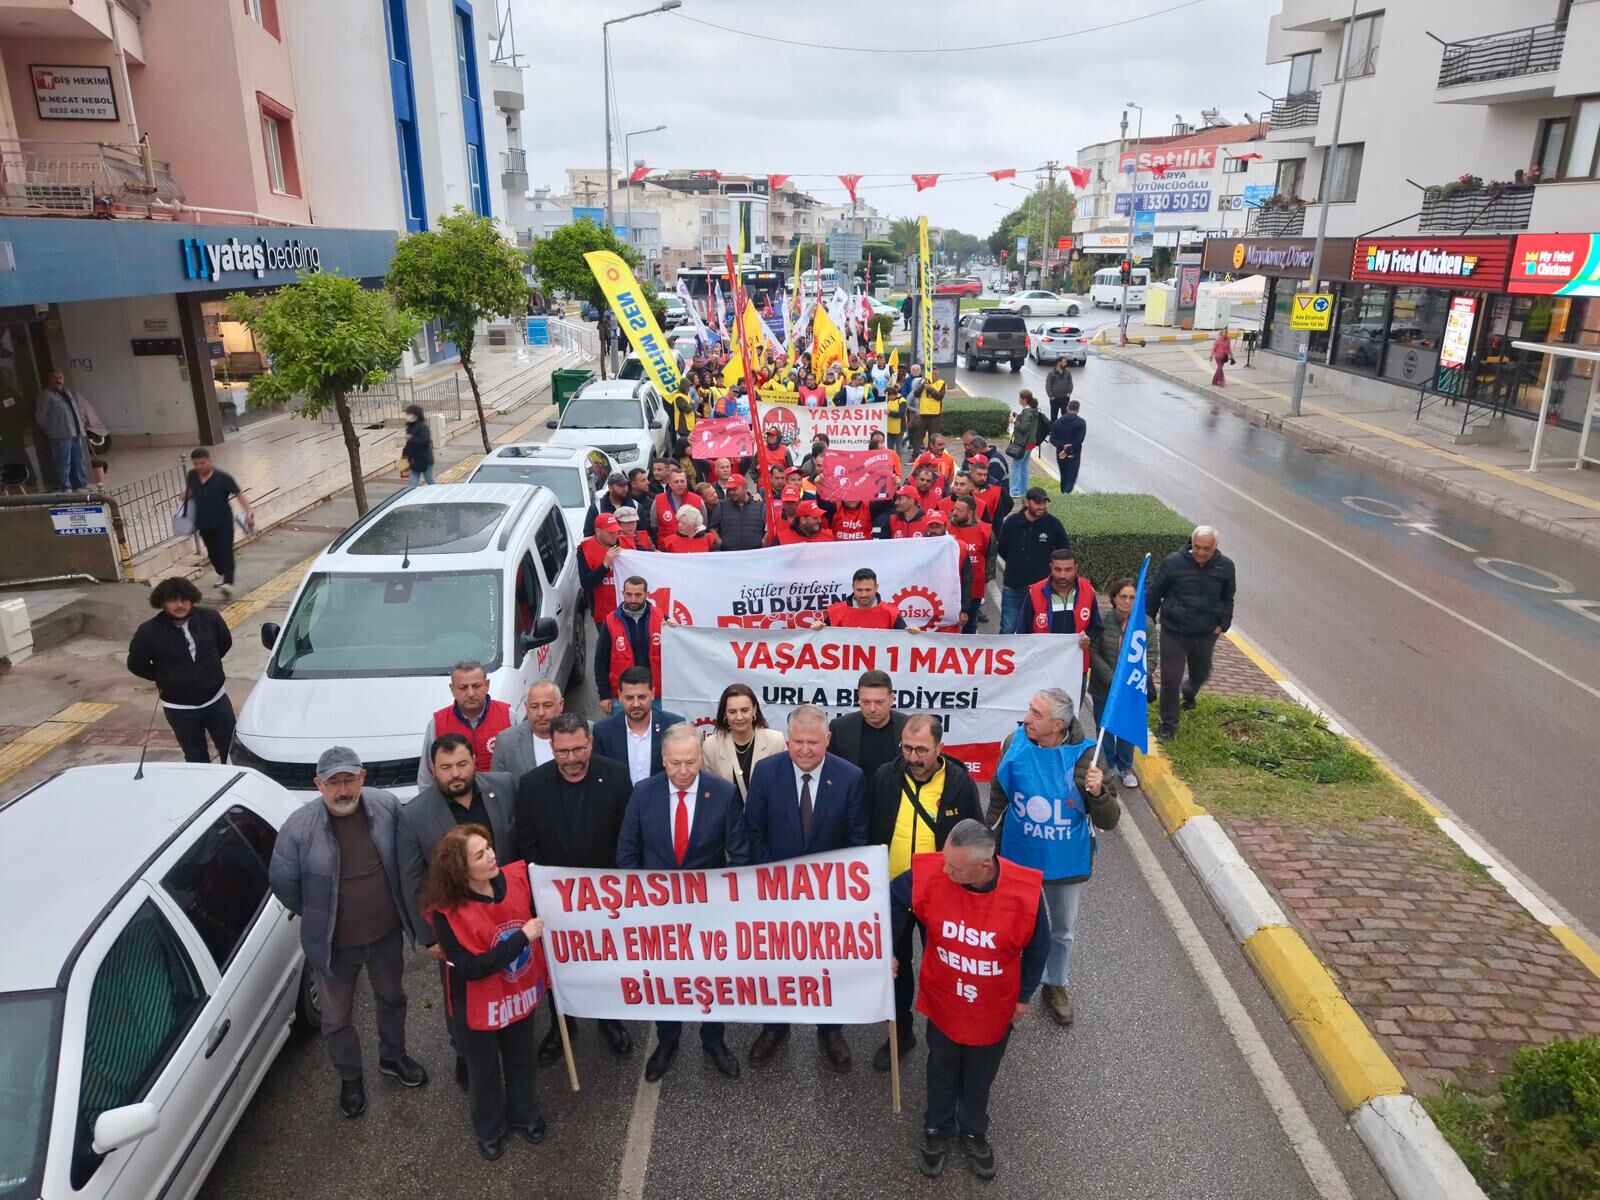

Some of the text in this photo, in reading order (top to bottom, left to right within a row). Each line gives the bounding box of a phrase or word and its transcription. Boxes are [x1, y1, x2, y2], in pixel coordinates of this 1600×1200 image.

[54, 75, 110, 86] DİŞ HEKİMİ
[82, 97, 113, 105] NEBOL
[1139, 148, 1212, 168] Satılık
[1148, 193, 1170, 209] 330
[1172, 193, 1189, 208] 50
[1191, 192, 1208, 207] 50
[207, 237, 320, 281] yataş bedding
[1375, 249, 1391, 273] My
[1391, 247, 1419, 273] Fried
[1419, 247, 1463, 275] Chicken
[1539, 250, 1574, 263] My Fried
[1537, 263, 1571, 276] Chicken
[808, 409, 883, 424] YAŞASIN
[811, 425, 879, 437] 1 MAYIS
[837, 531, 865, 540] GENEL
[740, 580, 842, 600] işçiler birleşir
[732, 593, 847, 616] BU DÜZEN
[901, 605, 932, 618] DİSK
[730, 641, 1016, 676] YAŞASIN 1 MAYIS
[762, 686, 979, 709] URLA BEDİYESİ
[1013, 791, 1071, 826] SOL
[1023, 822, 1071, 841] PARTİ
[552, 861, 871, 919] YAŞASIN 1 MAYIS
[551, 927, 619, 963] URLA
[623, 923, 694, 961] EMEK
[700, 929, 727, 960] ve
[735, 912, 883, 961] DEMOKRASİ
[942, 920, 997, 949] DİSK
[936, 946, 1003, 976] GENEL
[620, 968, 832, 1014] BİLEŞENLERİ
[956, 978, 978, 1003] İŞ
